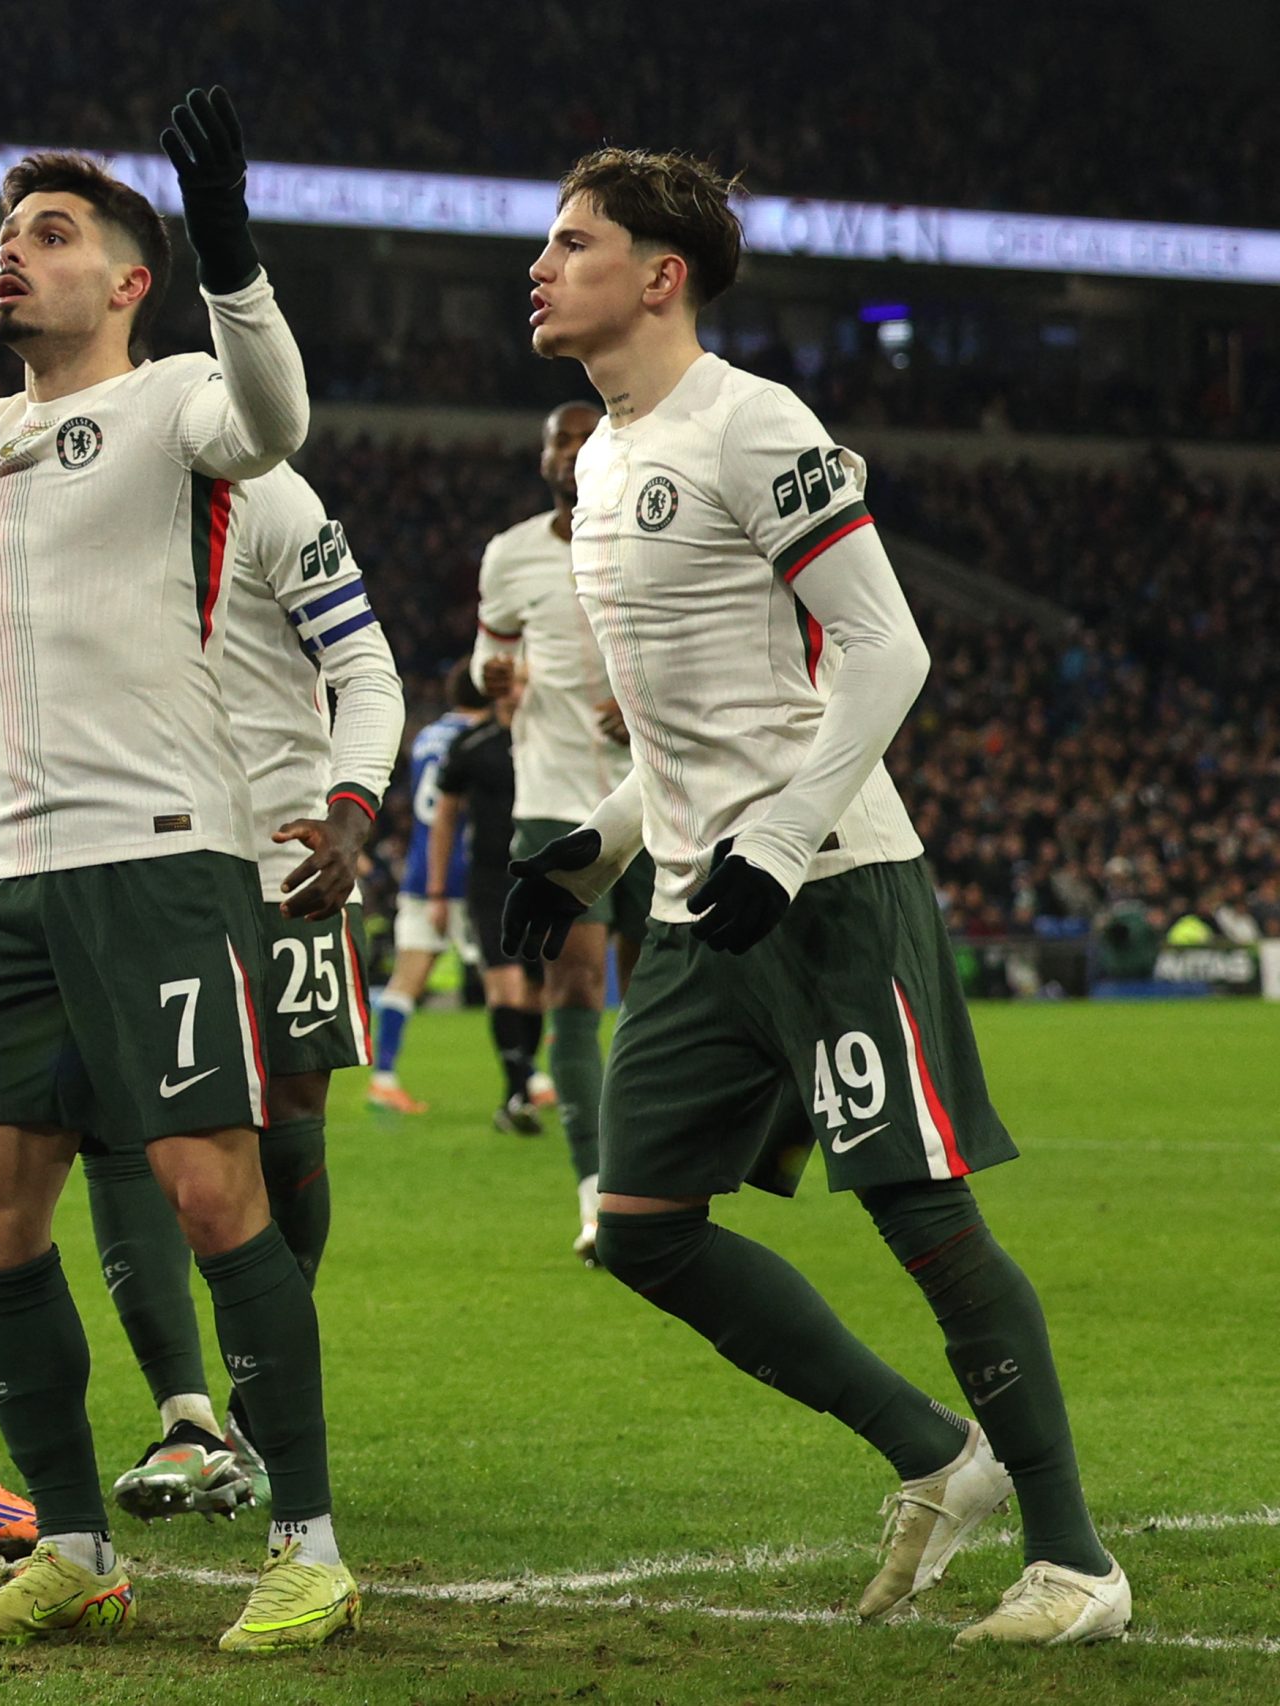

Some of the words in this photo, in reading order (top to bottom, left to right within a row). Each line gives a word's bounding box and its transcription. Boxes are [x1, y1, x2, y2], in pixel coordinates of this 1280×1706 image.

[781, 198, 951, 263] OWEN
[776, 455, 845, 510] FPT
[303, 528, 346, 573] FPT
[273, 932, 340, 1014] 25
[160, 977, 201, 1068] 7
[814, 1030, 887, 1129] 49
[274, 1519, 308, 1535] Neto
